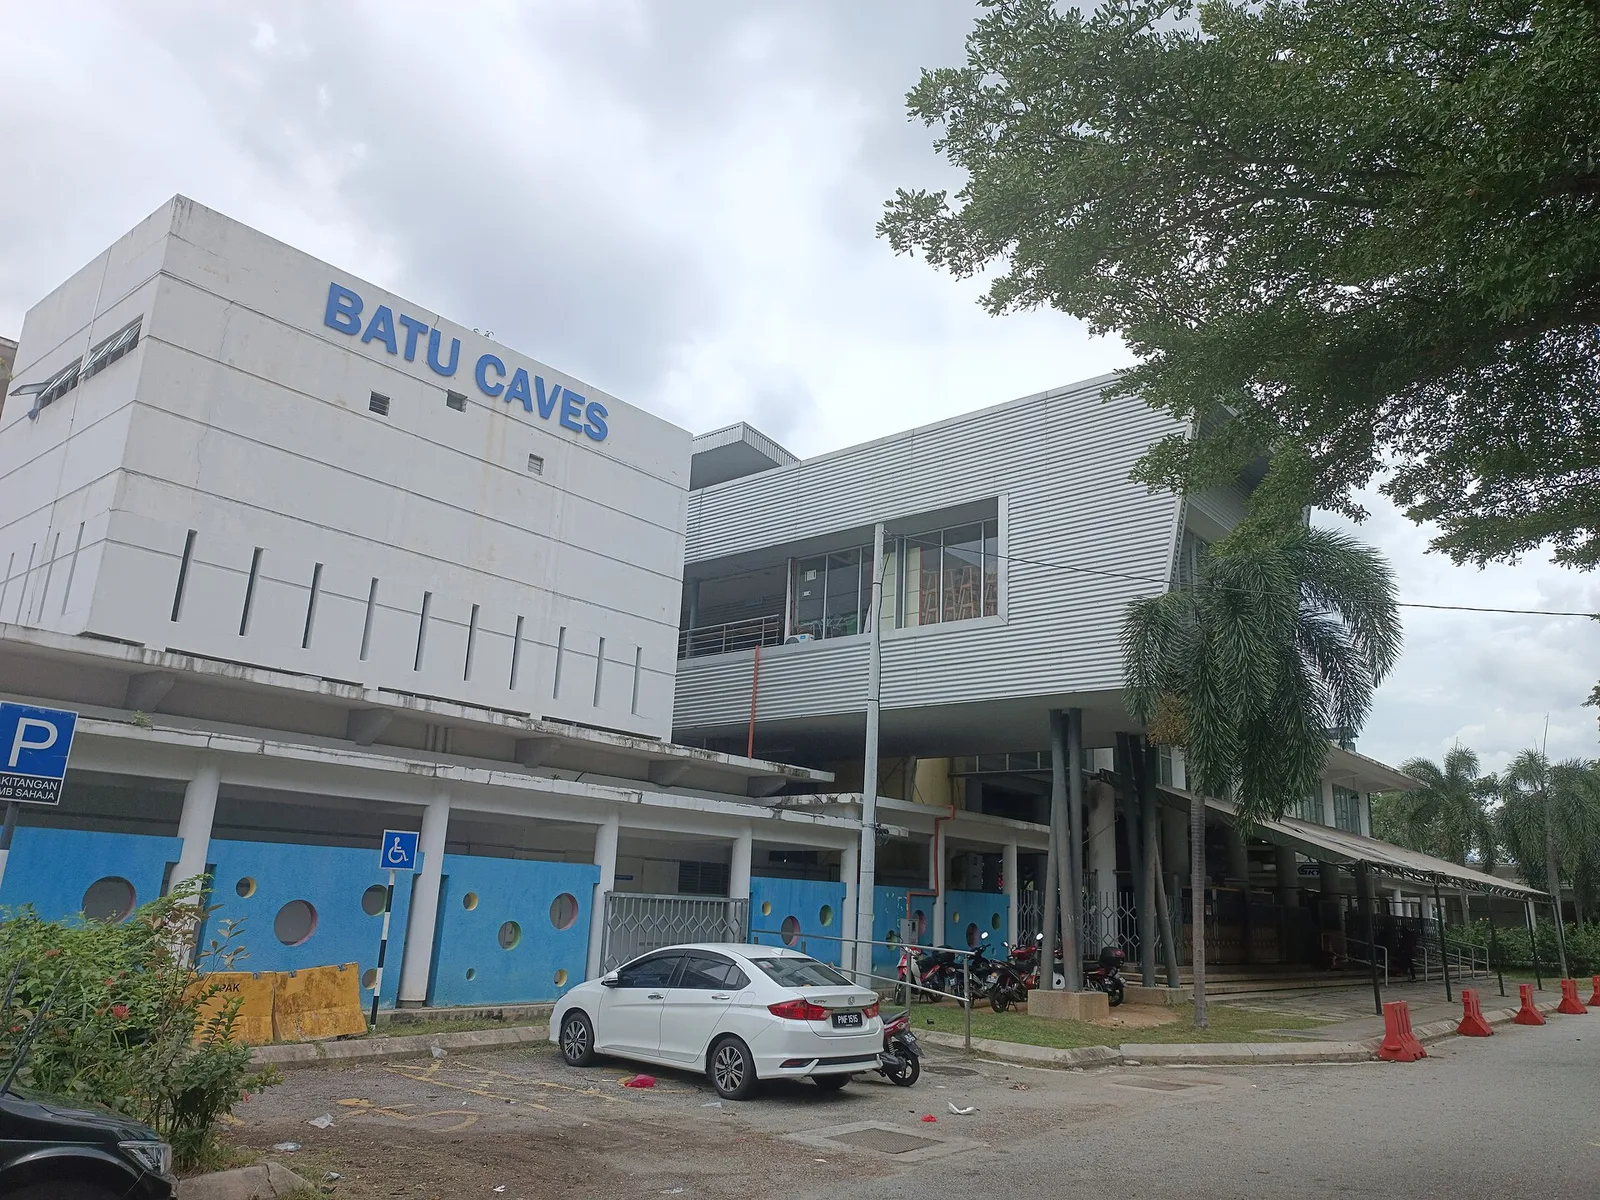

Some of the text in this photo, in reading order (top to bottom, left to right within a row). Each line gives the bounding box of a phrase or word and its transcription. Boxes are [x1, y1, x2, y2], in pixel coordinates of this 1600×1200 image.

[324, 281, 609, 442] BATU CAVES
[8, 717, 58, 767] P
[15, 788, 55, 800] SAHAJA
